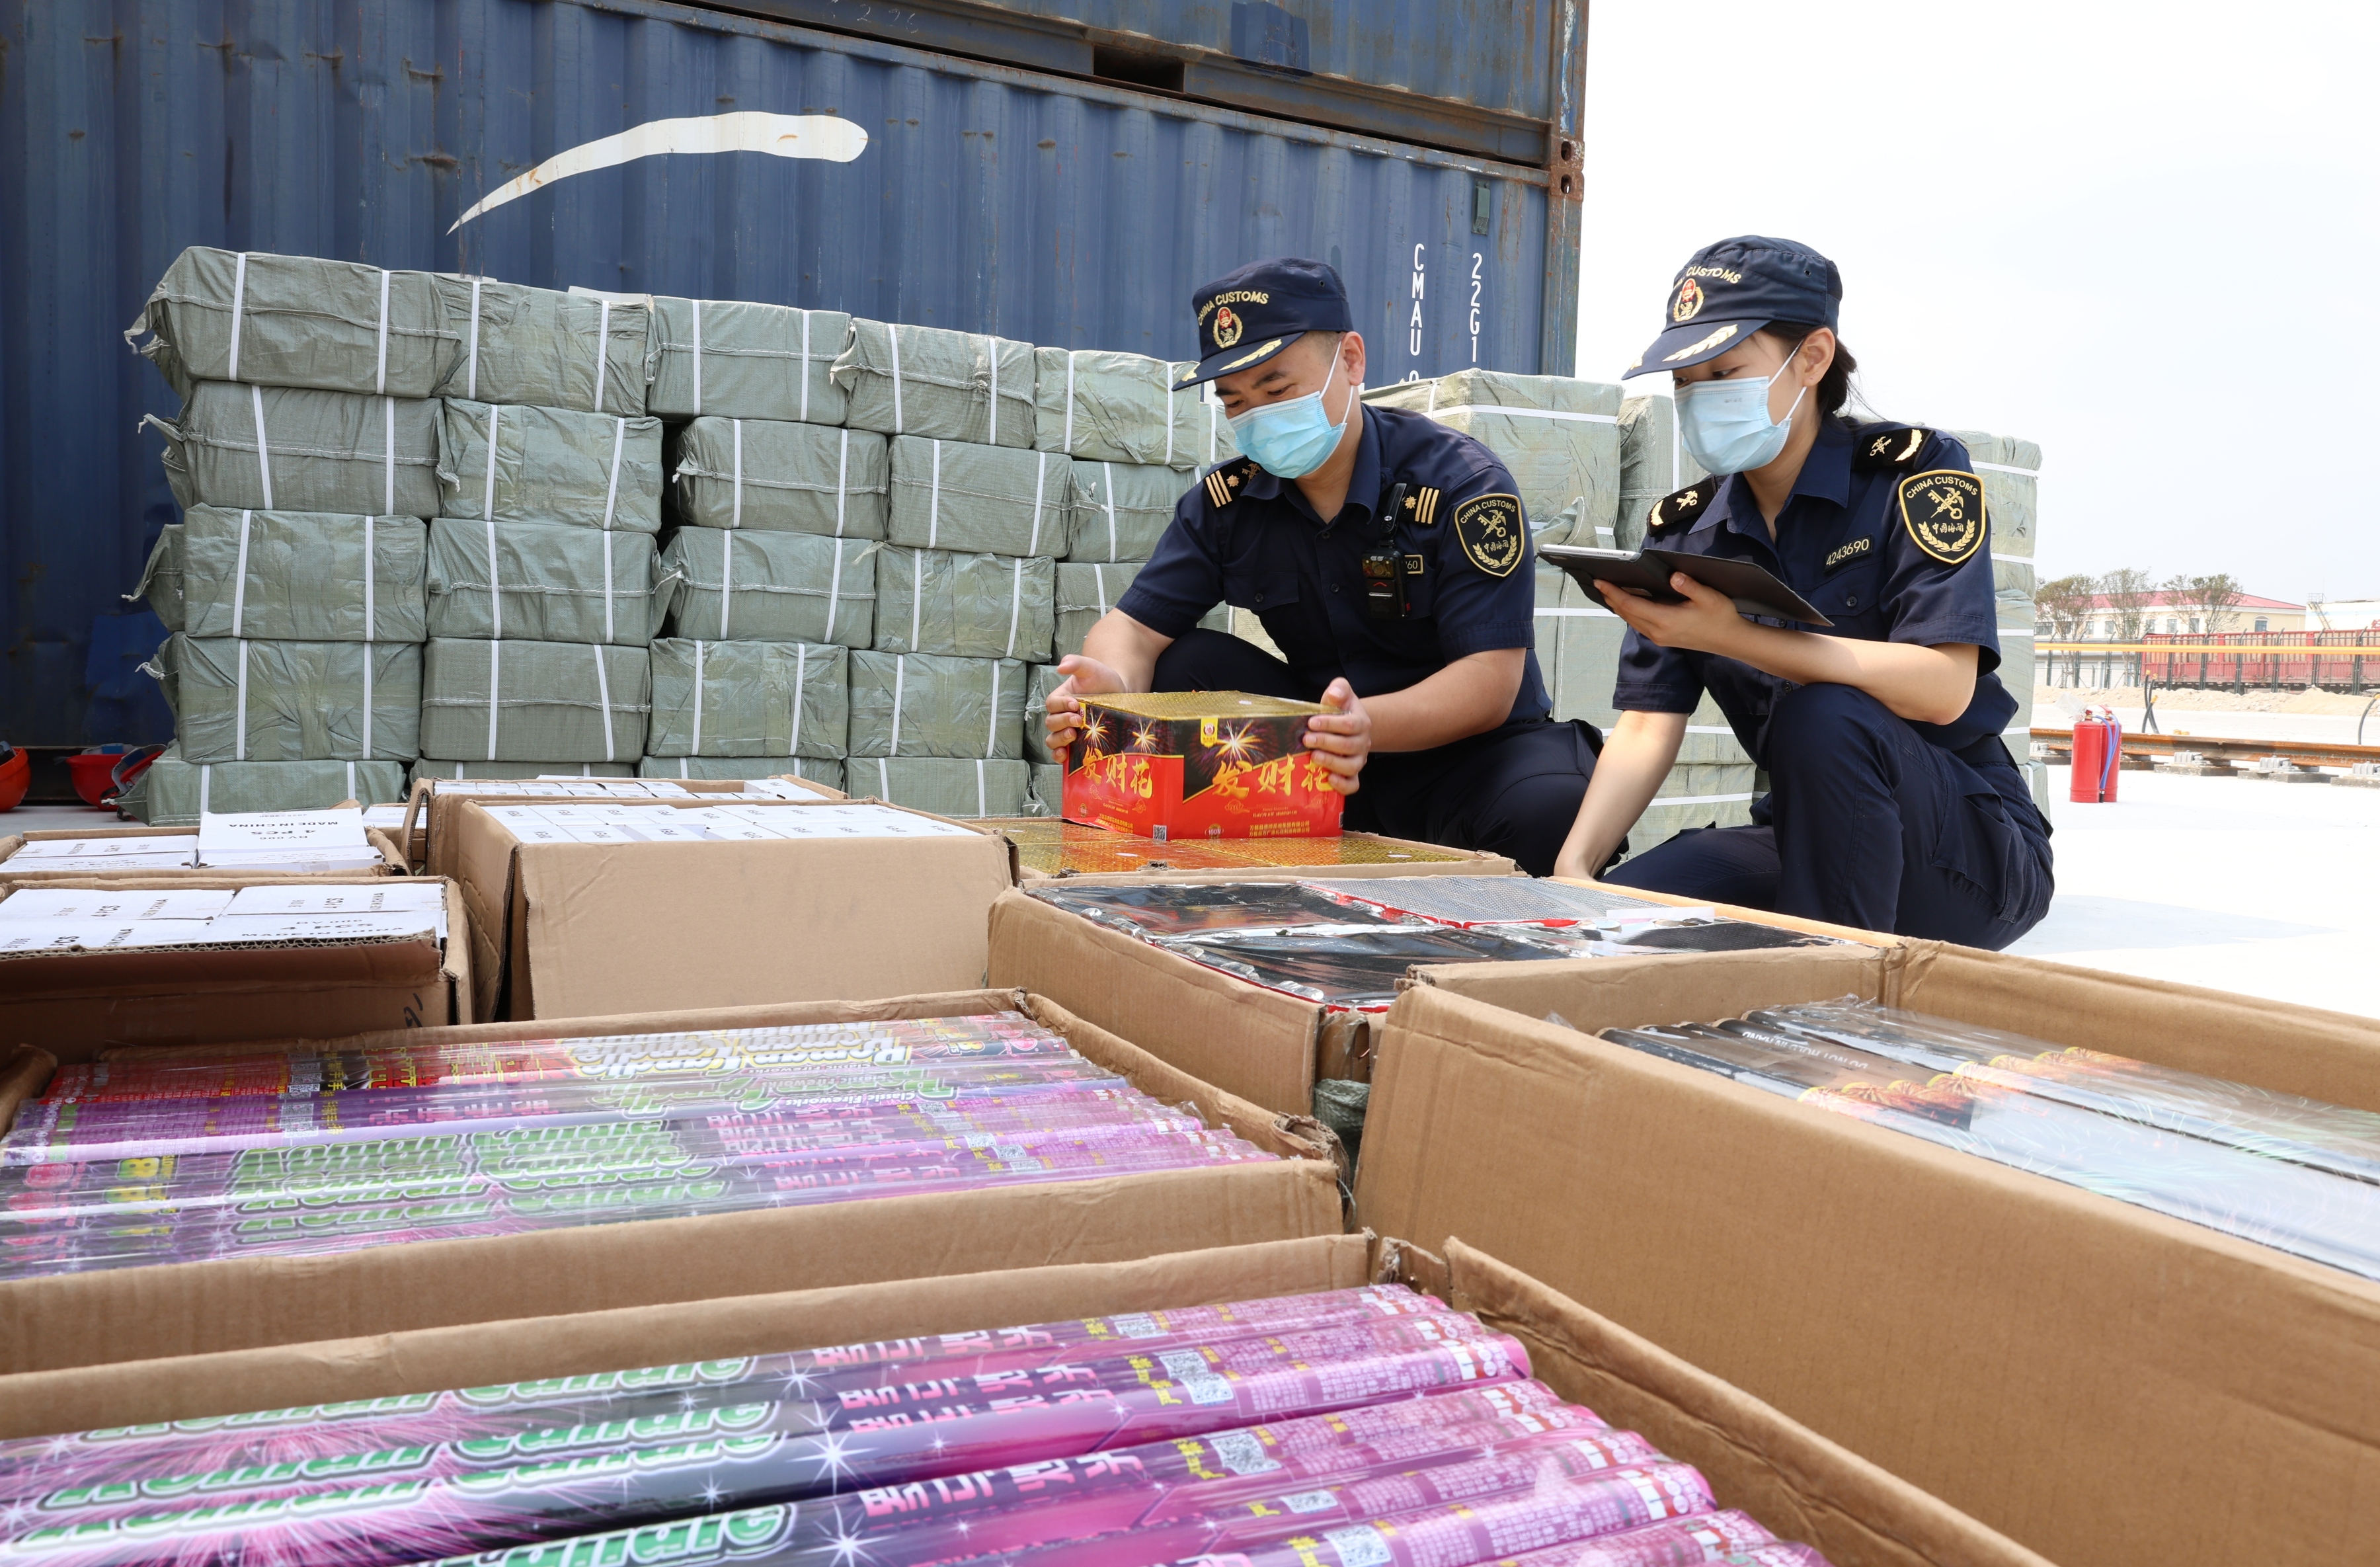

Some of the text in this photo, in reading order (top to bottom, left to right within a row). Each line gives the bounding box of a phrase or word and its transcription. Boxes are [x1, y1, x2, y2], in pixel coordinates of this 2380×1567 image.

[1686, 266, 1742, 284] CUSTOMS
[1198, 291, 1269, 326] CHINA CUSTOMS
[1410, 243, 1425, 356] CMAU
[1469, 253, 1482, 362] 22G1
[1906, 476, 1979, 499] CHINA CUSTOMS
[1460, 499, 1516, 524] CHINA CUSTOMS
[1405, 559, 1418, 569] 60
[1826, 538, 1870, 566] 4243690
[1082, 744, 1153, 799] 发财花
[95, 905, 121, 914] PCS
[784, 1091, 916, 1107] Classic Fireworks
